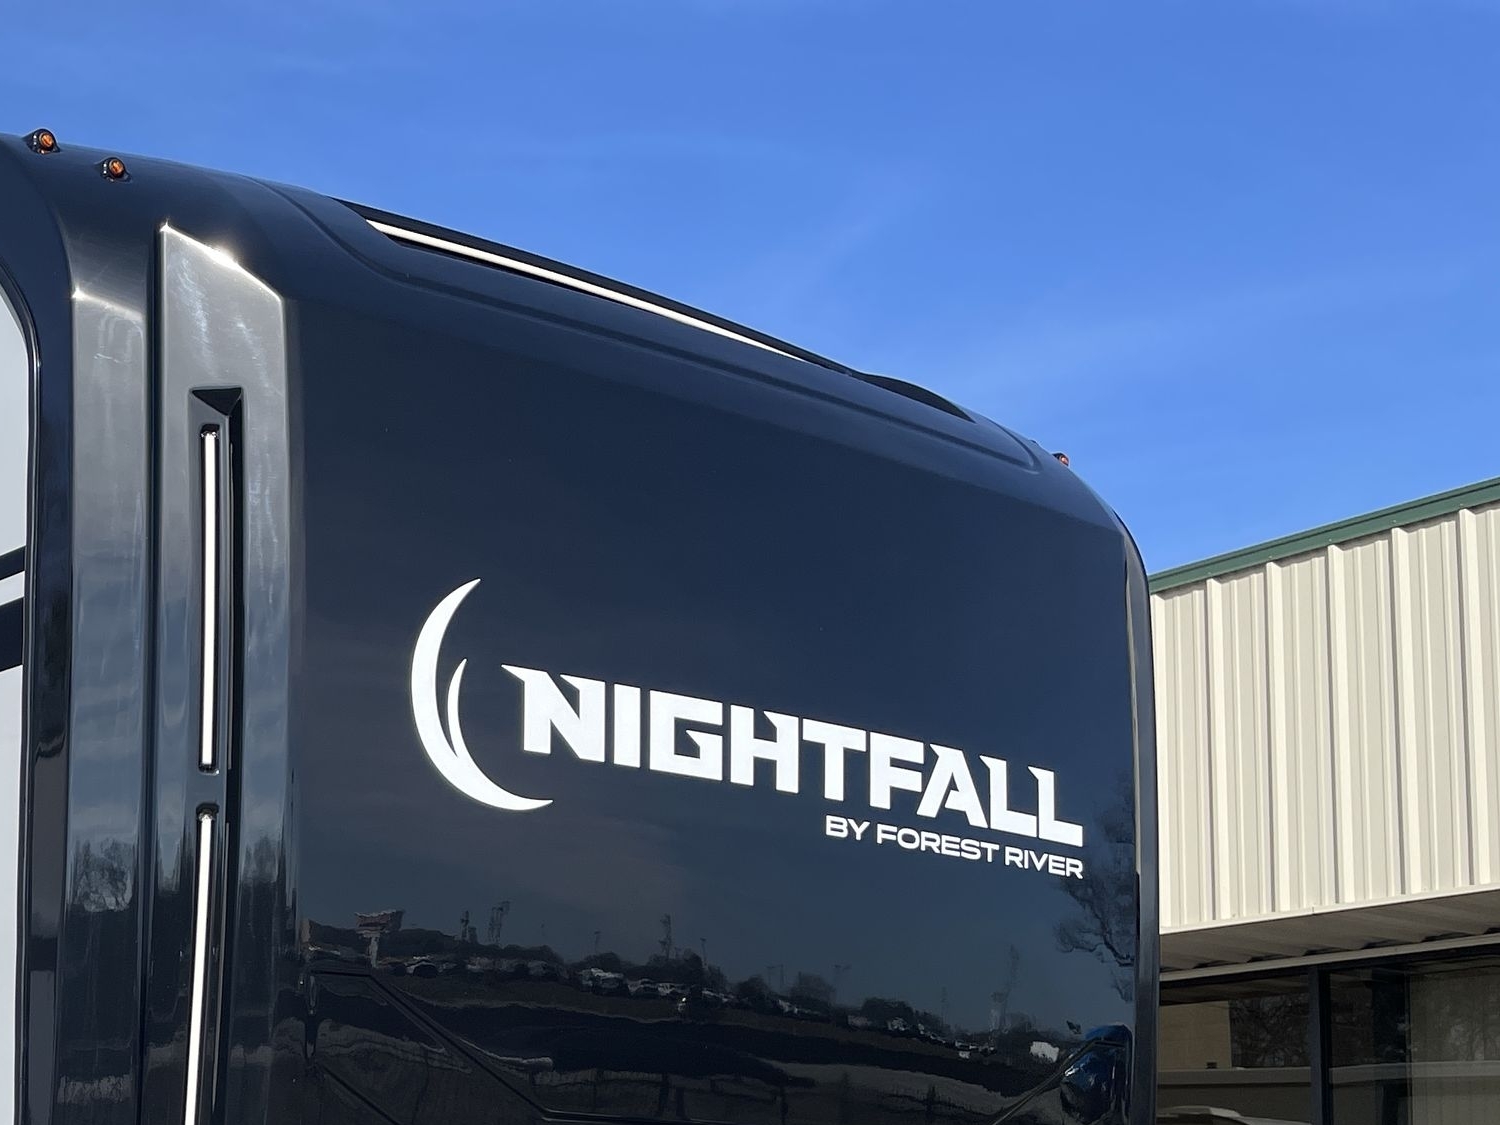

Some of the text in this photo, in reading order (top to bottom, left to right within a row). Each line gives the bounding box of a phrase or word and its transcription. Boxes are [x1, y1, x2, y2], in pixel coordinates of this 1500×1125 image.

[500, 663, 1083, 848] NIGHTFALL
[824, 814, 1084, 880] BY FOREST RIVER
